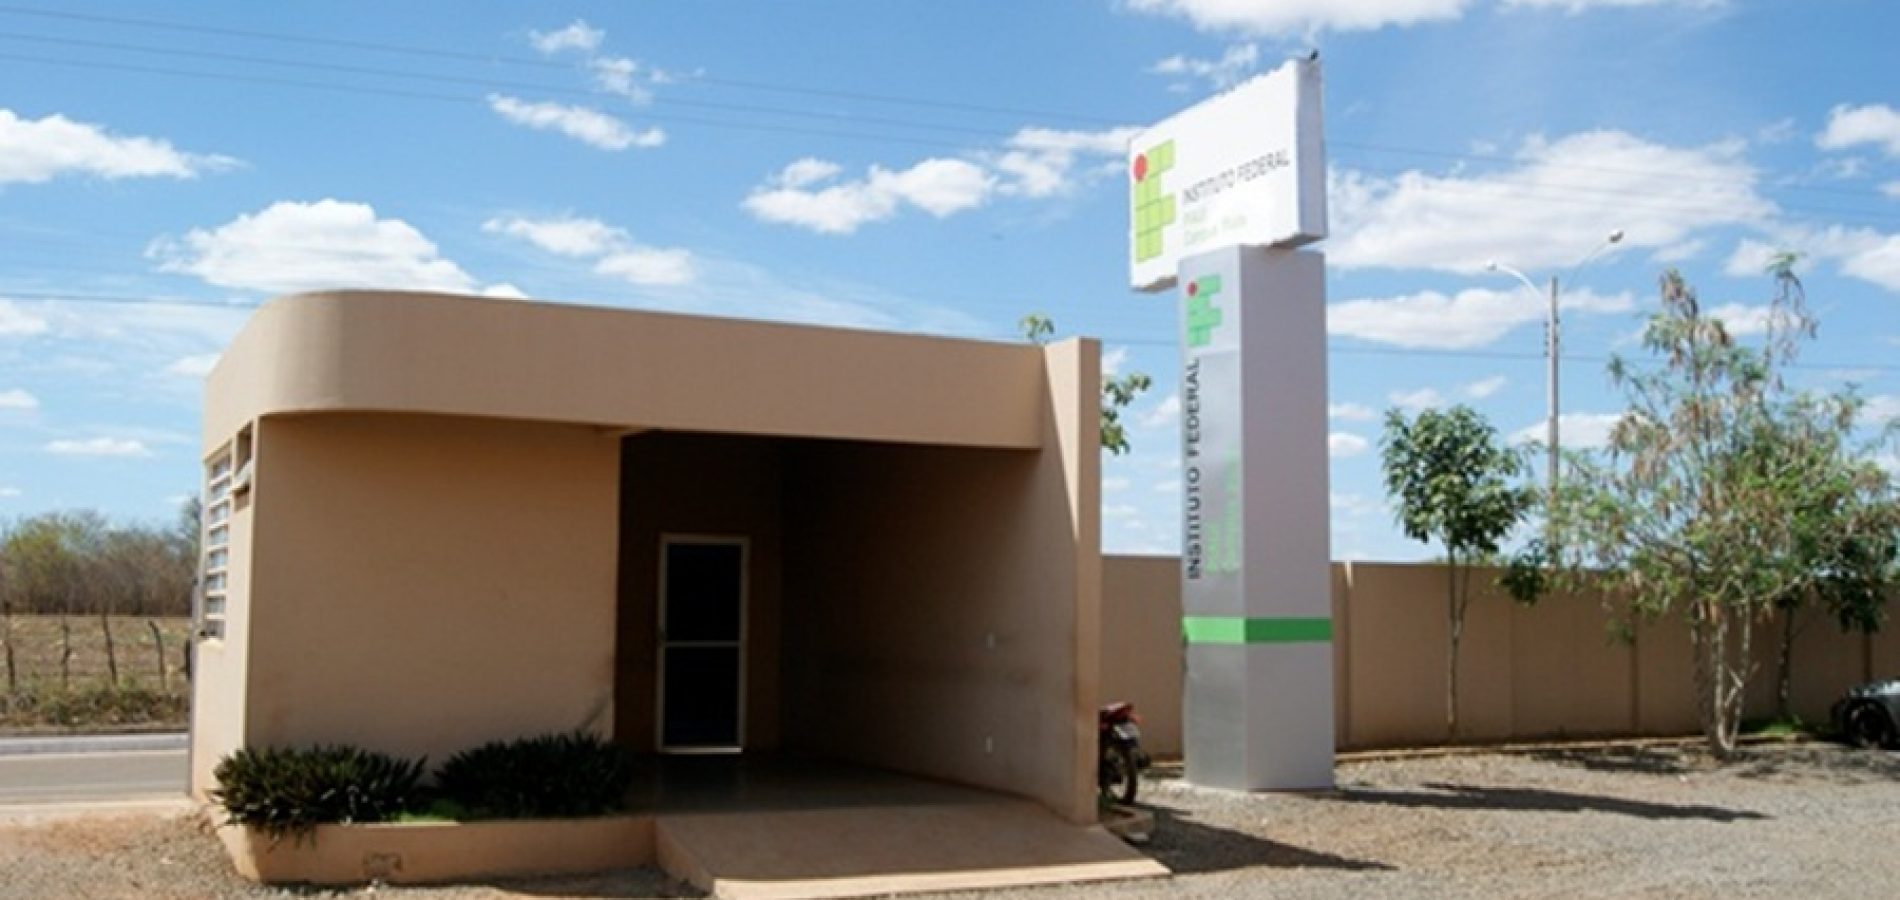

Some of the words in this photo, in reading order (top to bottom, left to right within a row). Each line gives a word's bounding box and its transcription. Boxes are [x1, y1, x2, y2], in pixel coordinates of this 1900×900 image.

[1183, 168, 1234, 203] INSTITUTO
[1237, 149, 1289, 182] FEDERAL
[1186, 358, 1200, 457] FEDERAL
[1186, 466, 1201, 579] INSTITUTO
